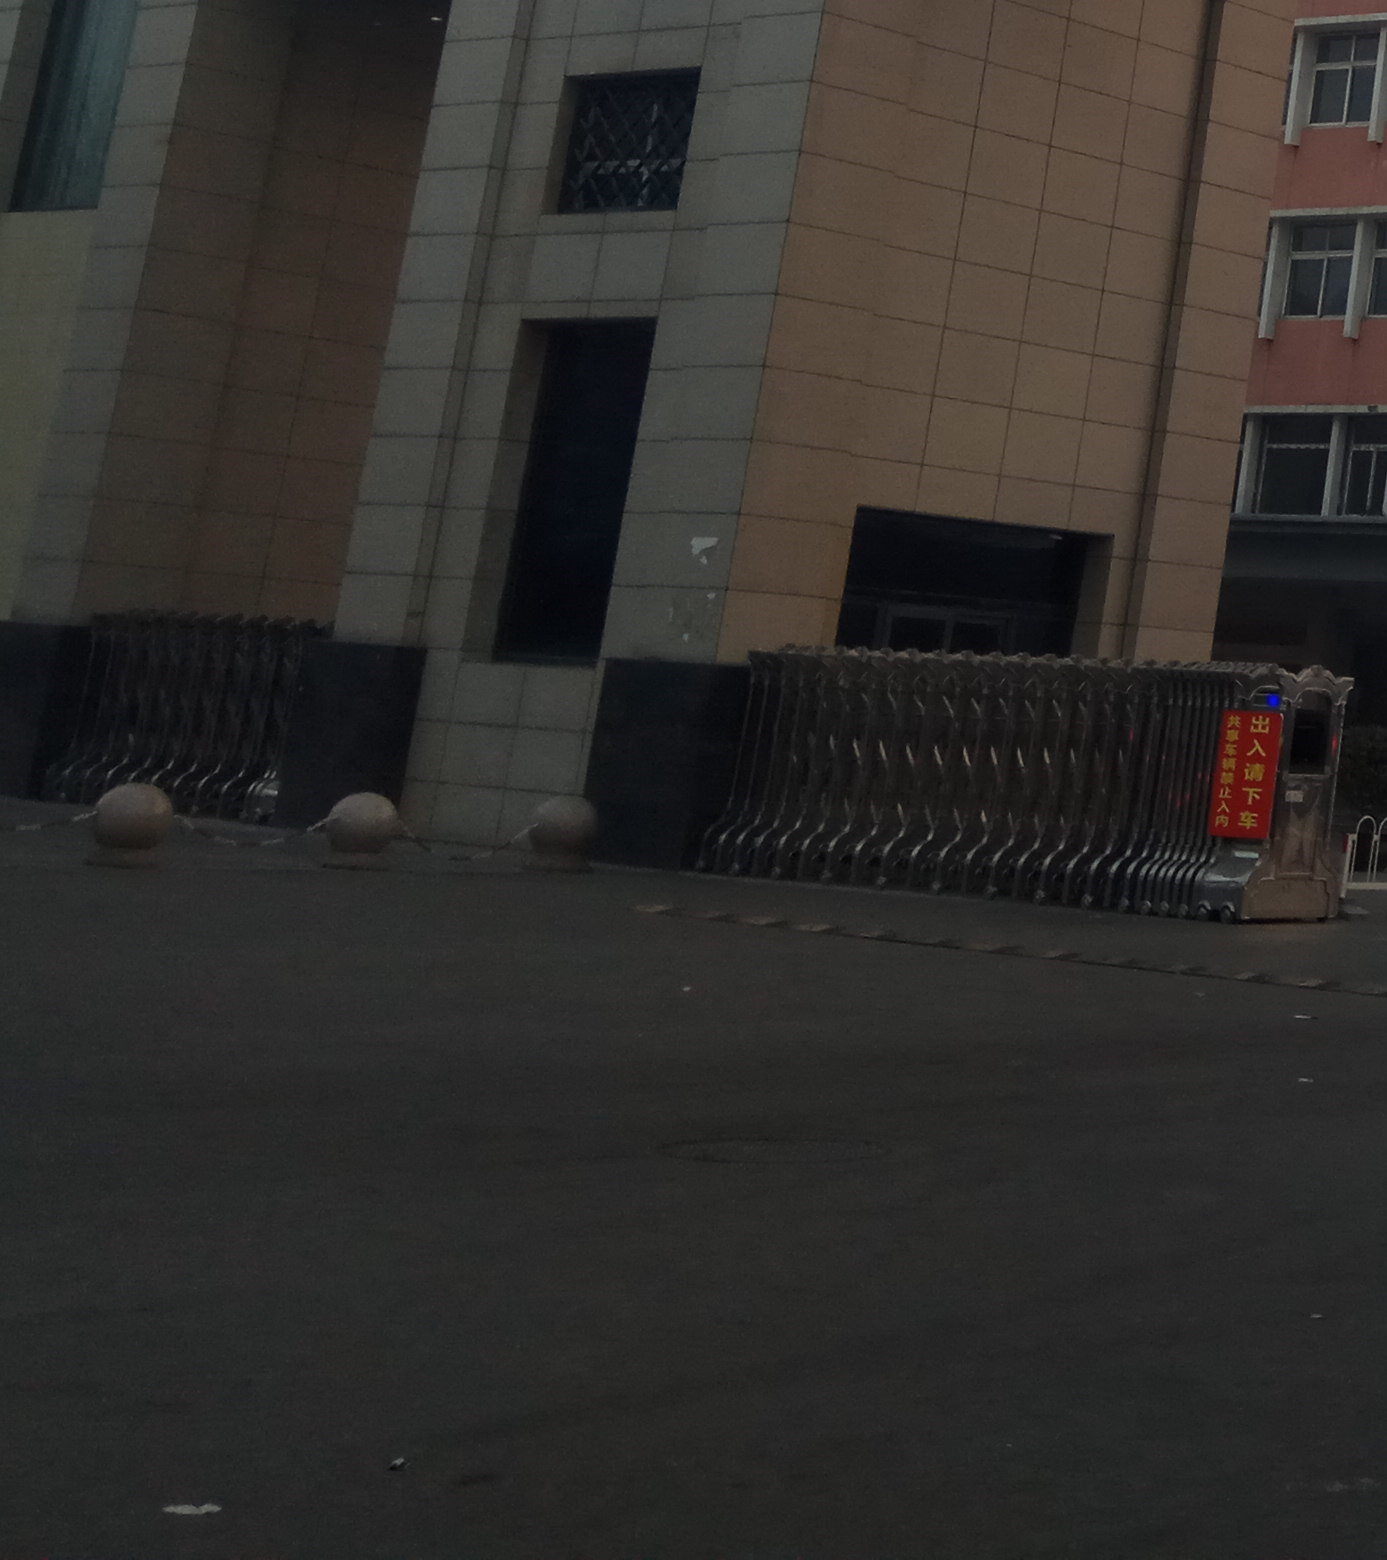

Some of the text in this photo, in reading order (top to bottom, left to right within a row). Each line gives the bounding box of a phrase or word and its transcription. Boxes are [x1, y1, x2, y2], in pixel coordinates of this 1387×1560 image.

[1238, 715, 1270, 830] 出入请下车
